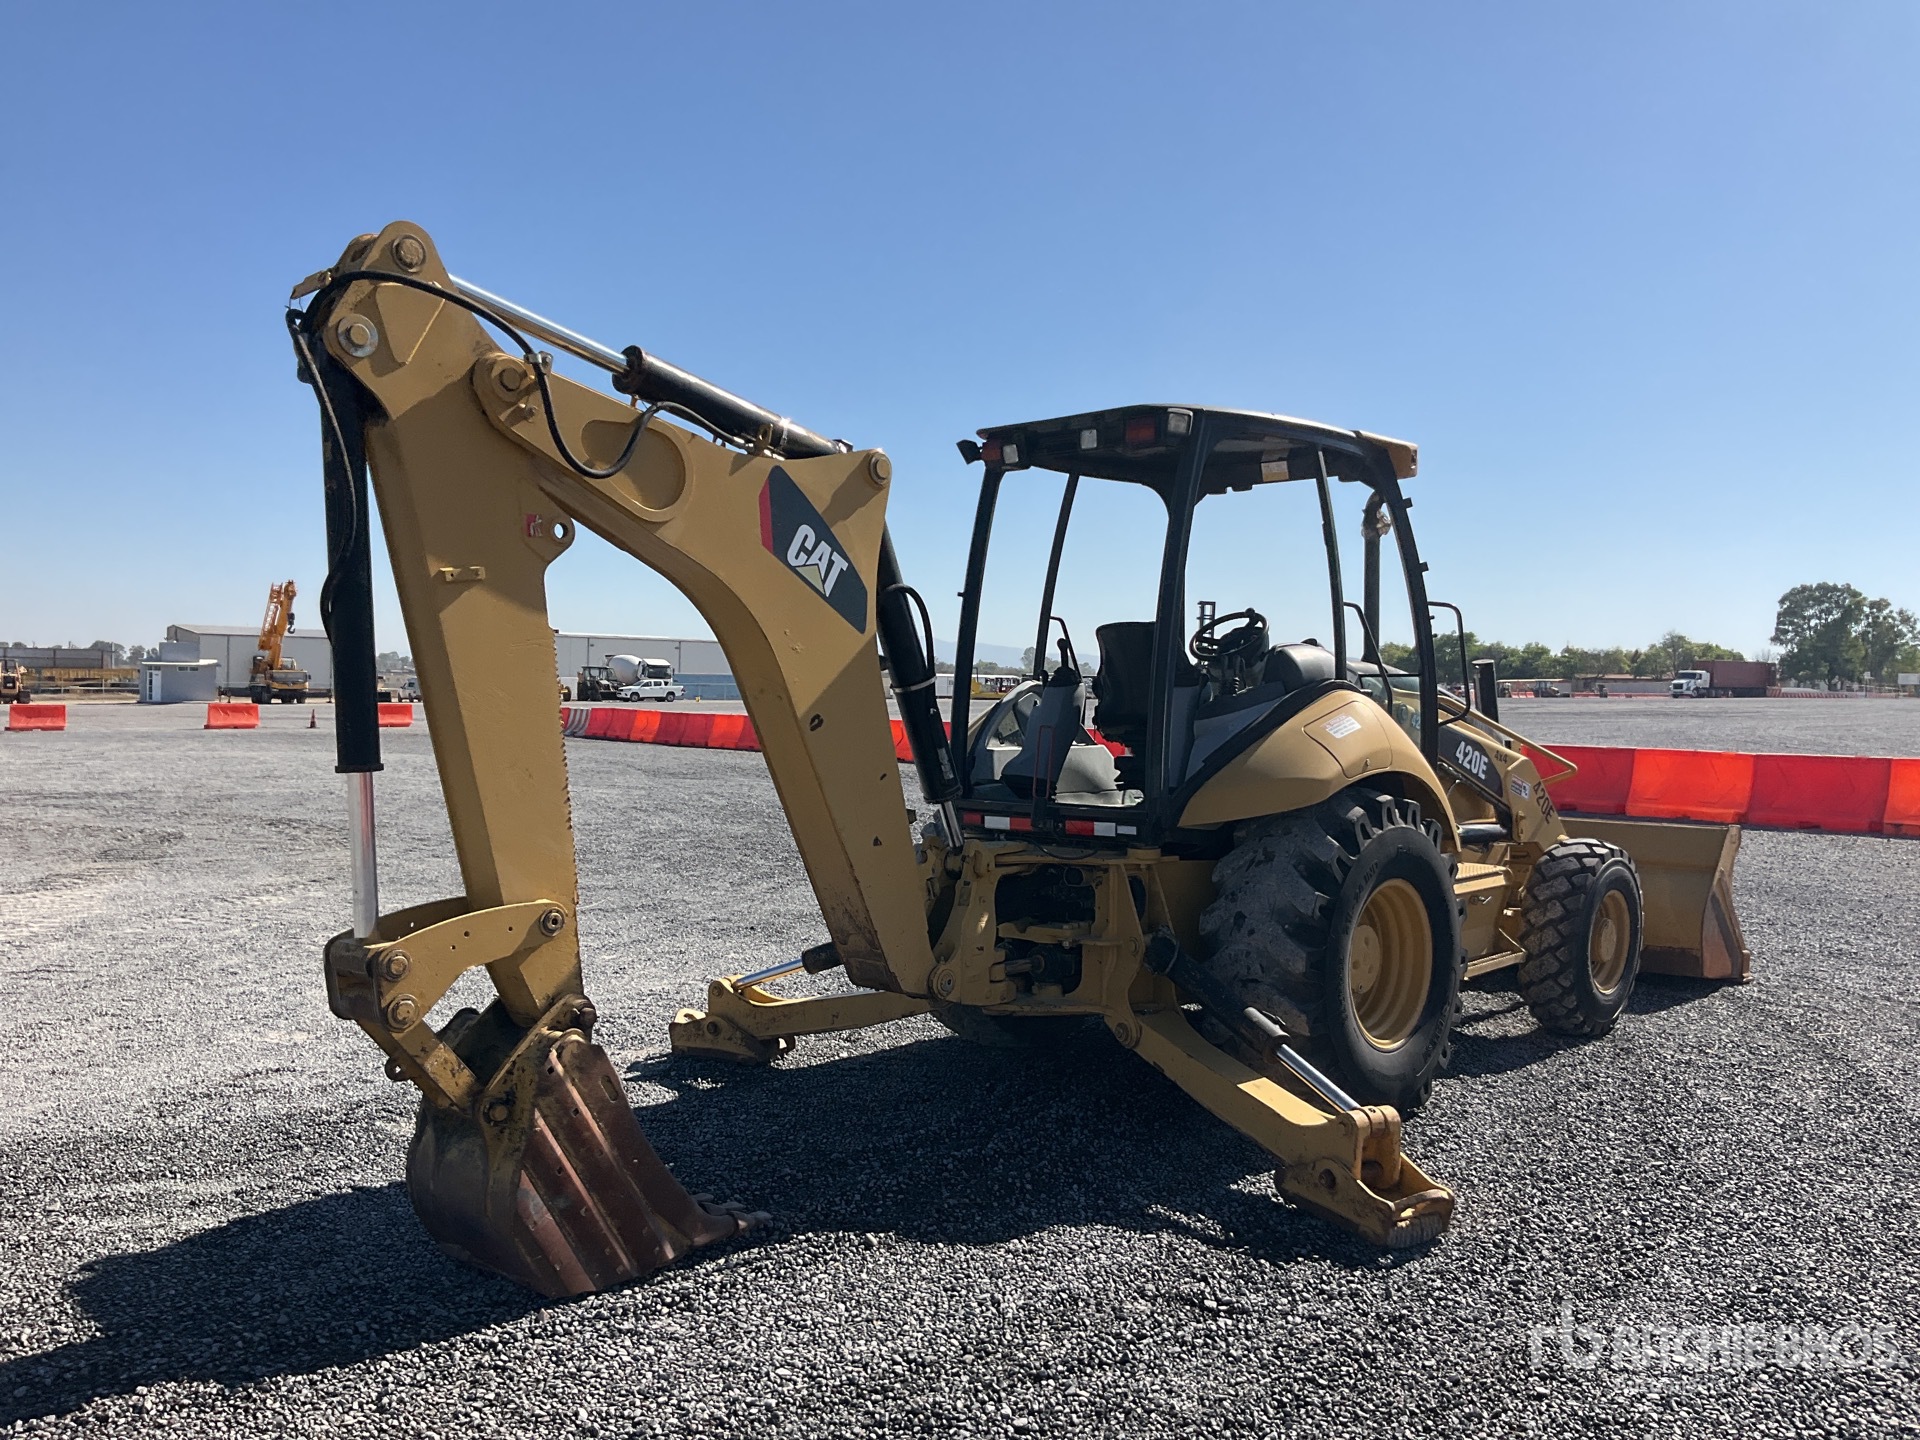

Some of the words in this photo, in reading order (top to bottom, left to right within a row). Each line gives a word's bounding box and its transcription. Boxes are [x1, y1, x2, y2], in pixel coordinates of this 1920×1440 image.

[786, 523, 849, 598] CAT
[1455, 740, 1489, 780] 420E
[1532, 780, 1555, 824] 420E
